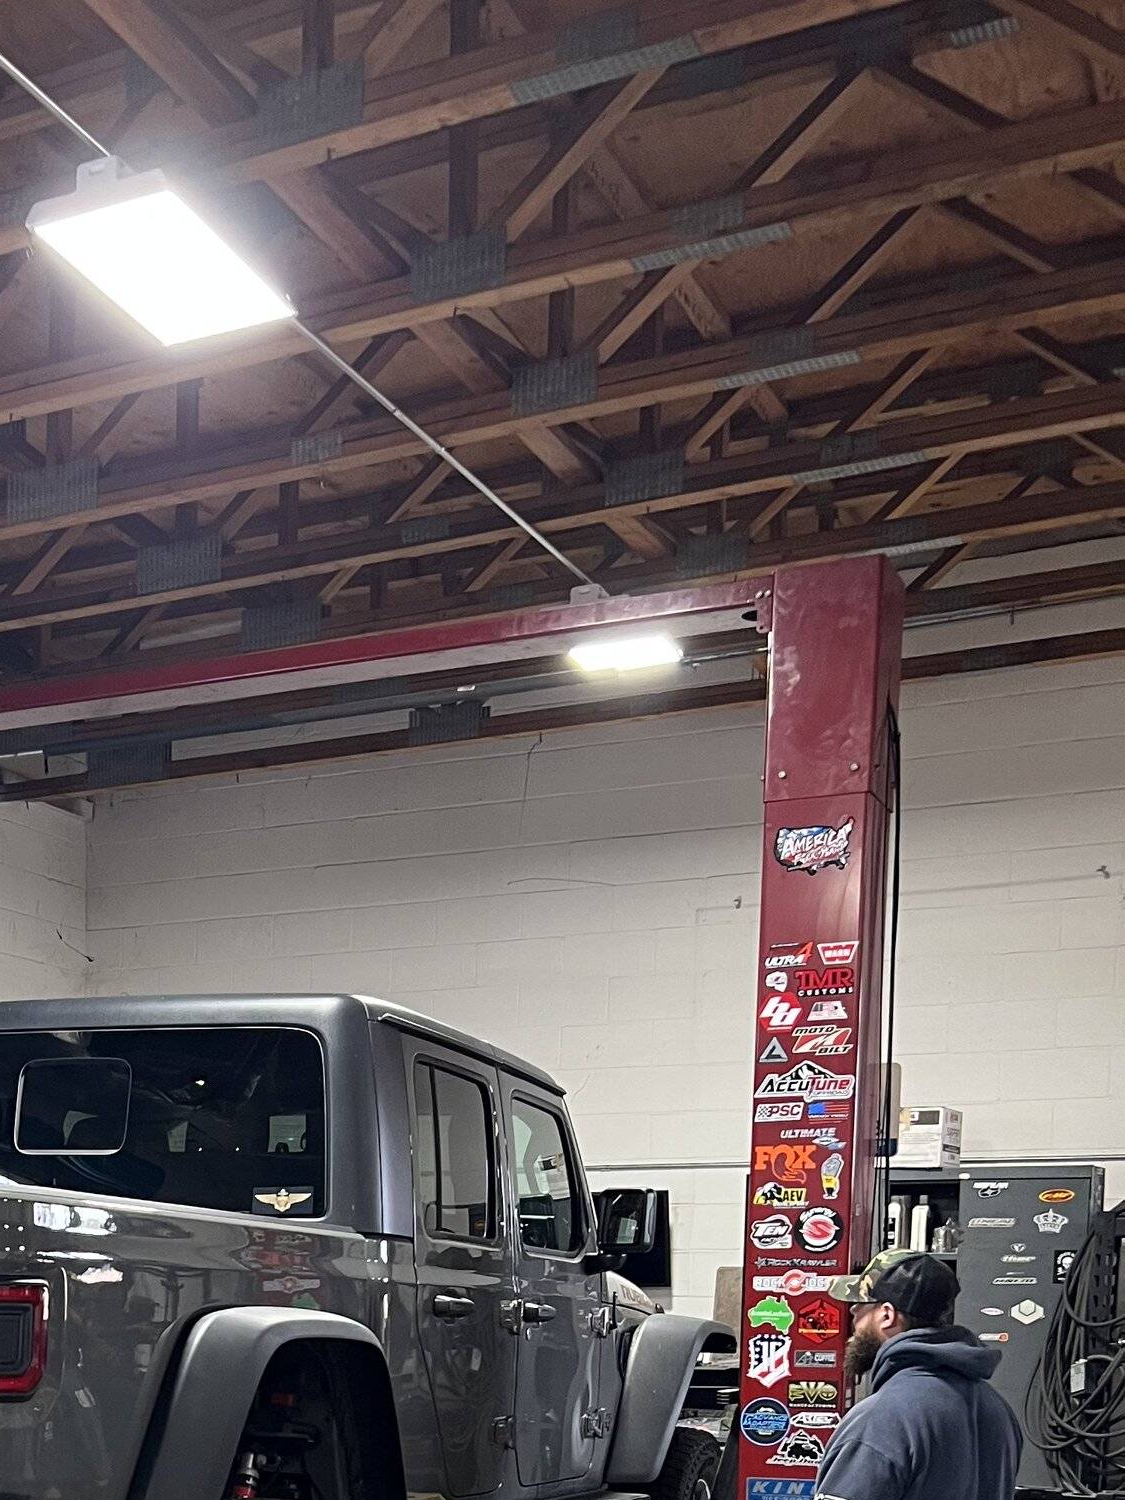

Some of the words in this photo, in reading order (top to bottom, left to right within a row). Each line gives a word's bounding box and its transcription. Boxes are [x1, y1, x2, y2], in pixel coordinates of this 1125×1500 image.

[797, 987, 854, 997] CUSTOMS
[794, 1027, 835, 1035] MOTO
[818, 1045, 852, 1054] BILT
[780, 1128, 836, 1139] ULTIMATE
[755, 1145, 816, 1180] FOX
[783, 1190, 804, 1202] AEV
[789, 1381, 837, 1404] EVO
